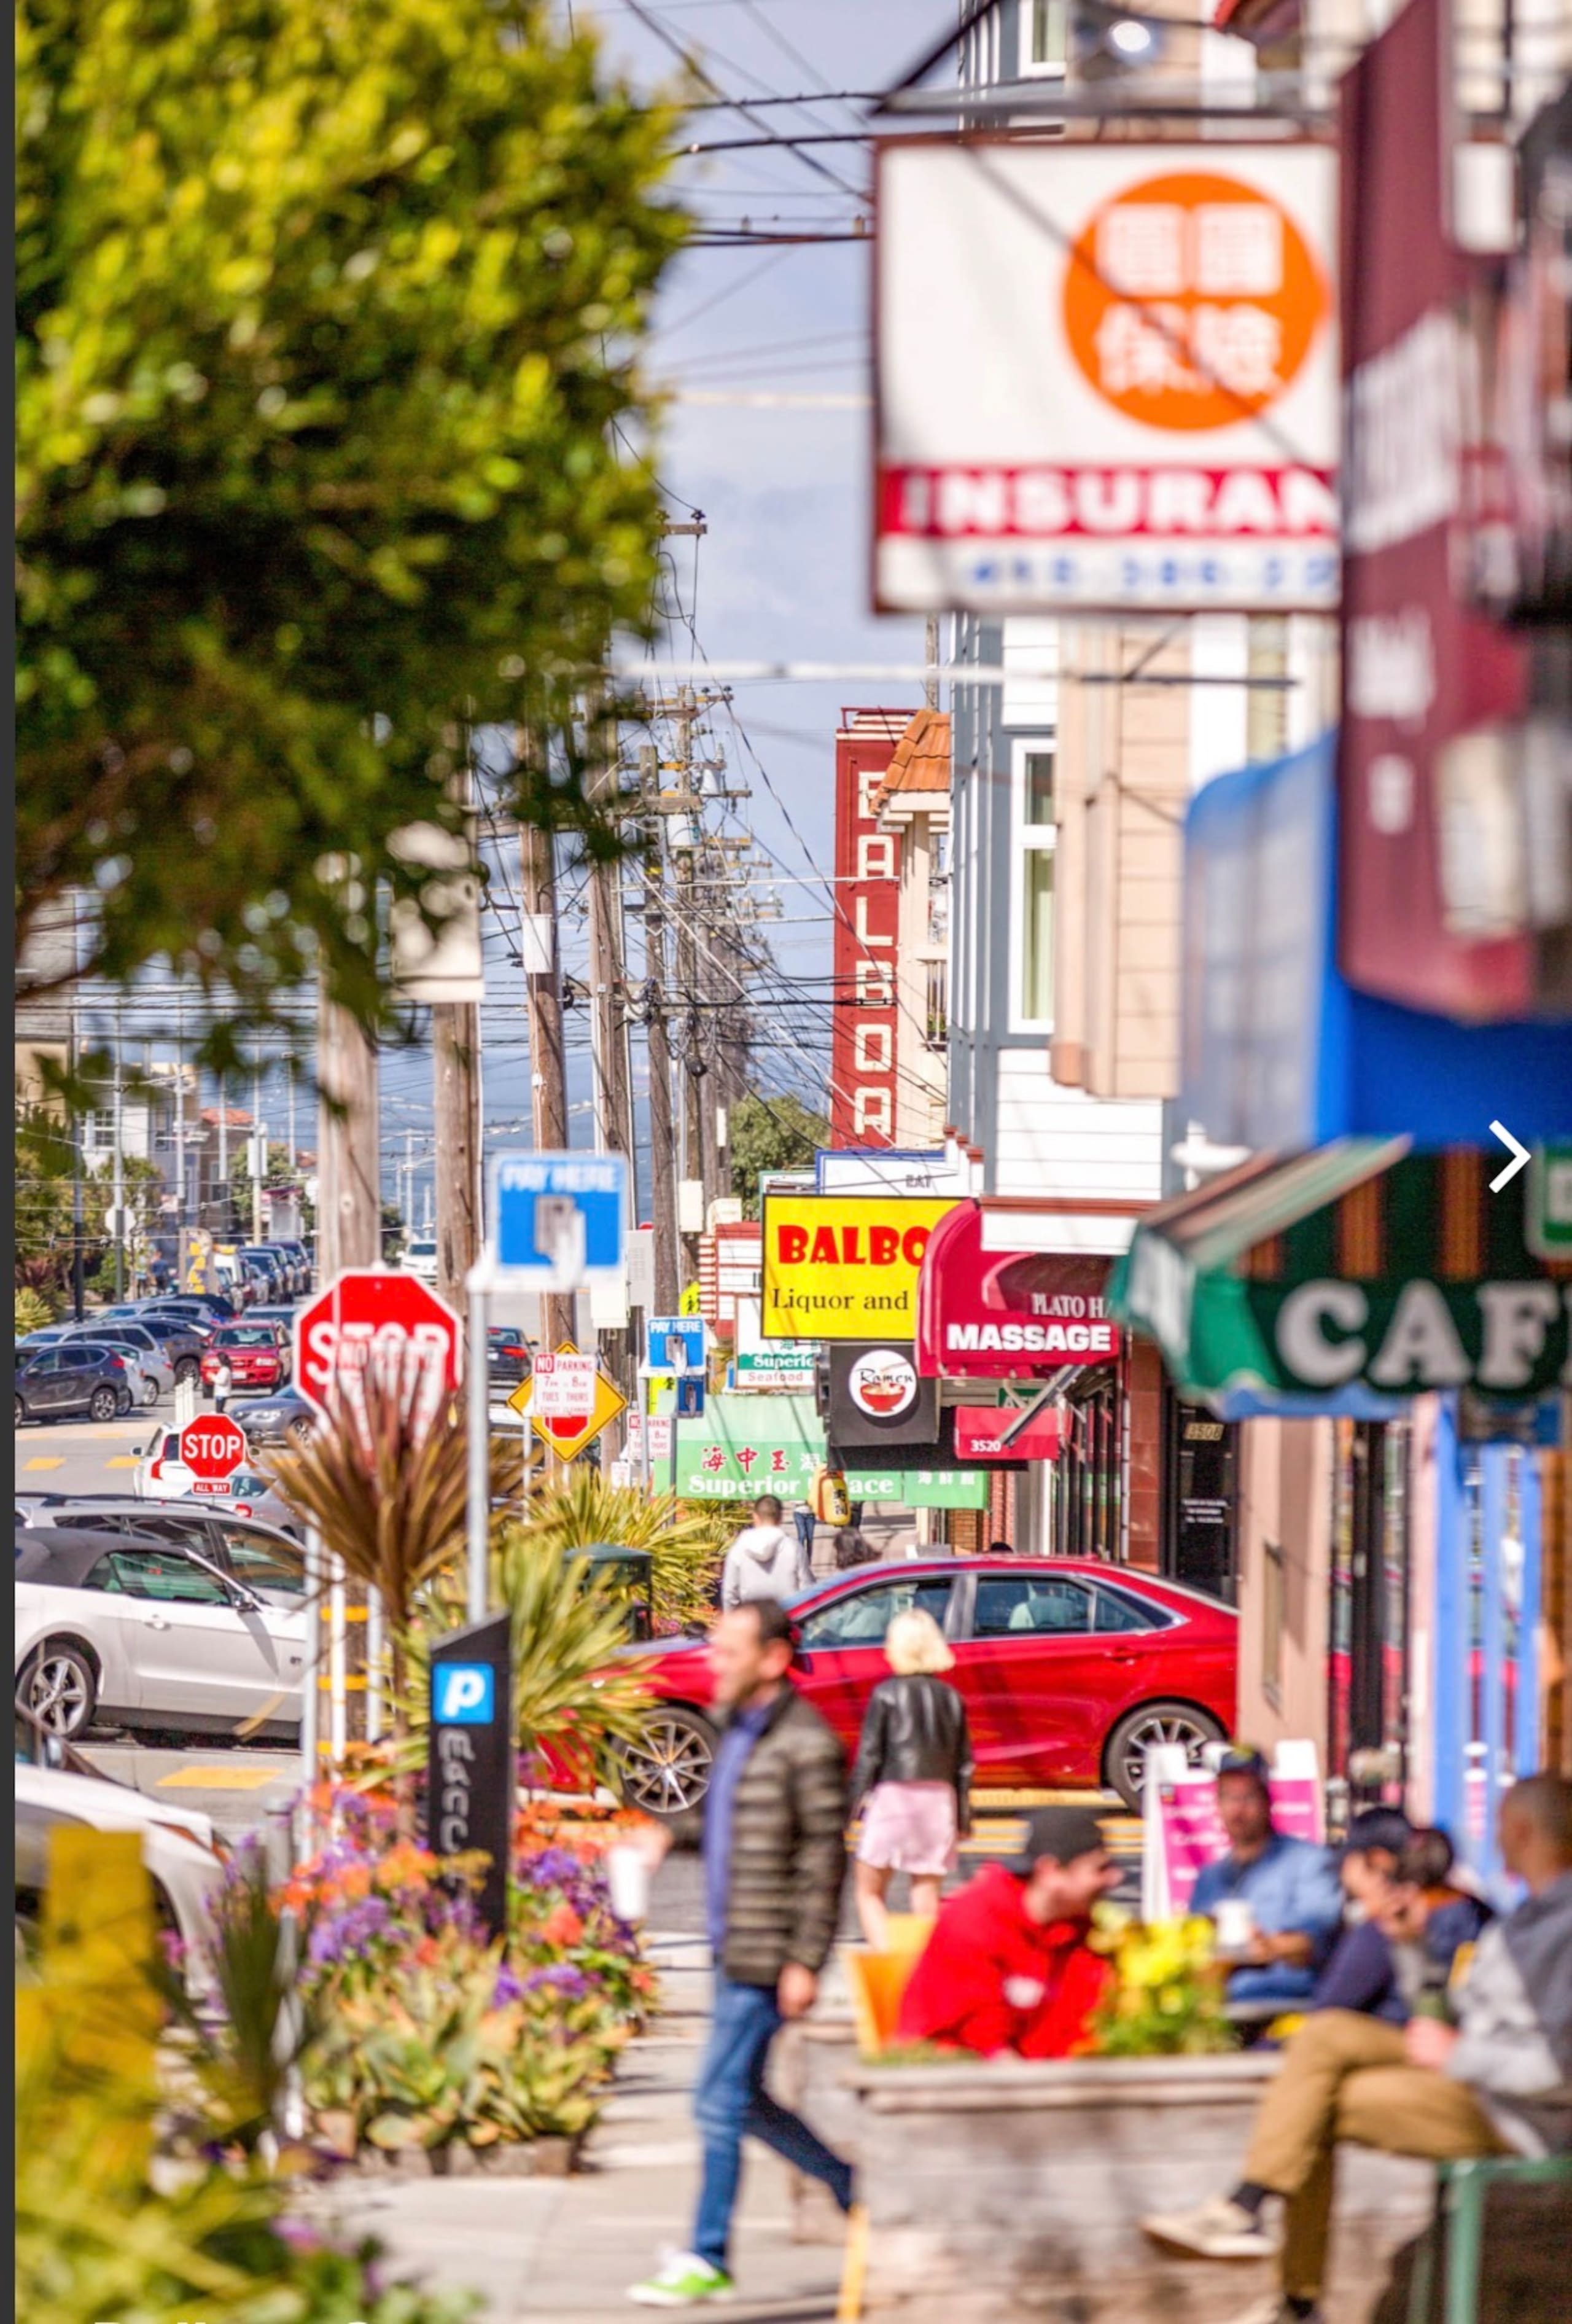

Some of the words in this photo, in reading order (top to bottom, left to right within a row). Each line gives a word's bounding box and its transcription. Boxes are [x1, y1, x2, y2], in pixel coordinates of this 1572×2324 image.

[855, 771, 894, 1136] BALBOA
[777, 1225, 932, 1267] BALBO
[772, 1289, 855, 1313] Liquor
[863, 1290, 909, 1310] and
[650, 1321, 670, 1333] PAY
[672, 1321, 702, 1333] HERE
[946, 1324, 1111, 1351] MASSAGE
[1275, 1279, 1572, 1388] CAF
[305, 1322, 450, 1386] SP
[537, 1355, 553, 1372] NO
[557, 1360, 593, 1373] PARKING
[748, 1371, 803, 1381] Seafood
[855, 1368, 912, 1384] Ramen
[184, 1433, 241, 1460] STOP
[970, 1440, 1002, 1452] 3520
[195, 1483, 210, 1492] ALL
[212, 1483, 228, 1492] WAY
[688, 1475, 801, 1498] Superior
